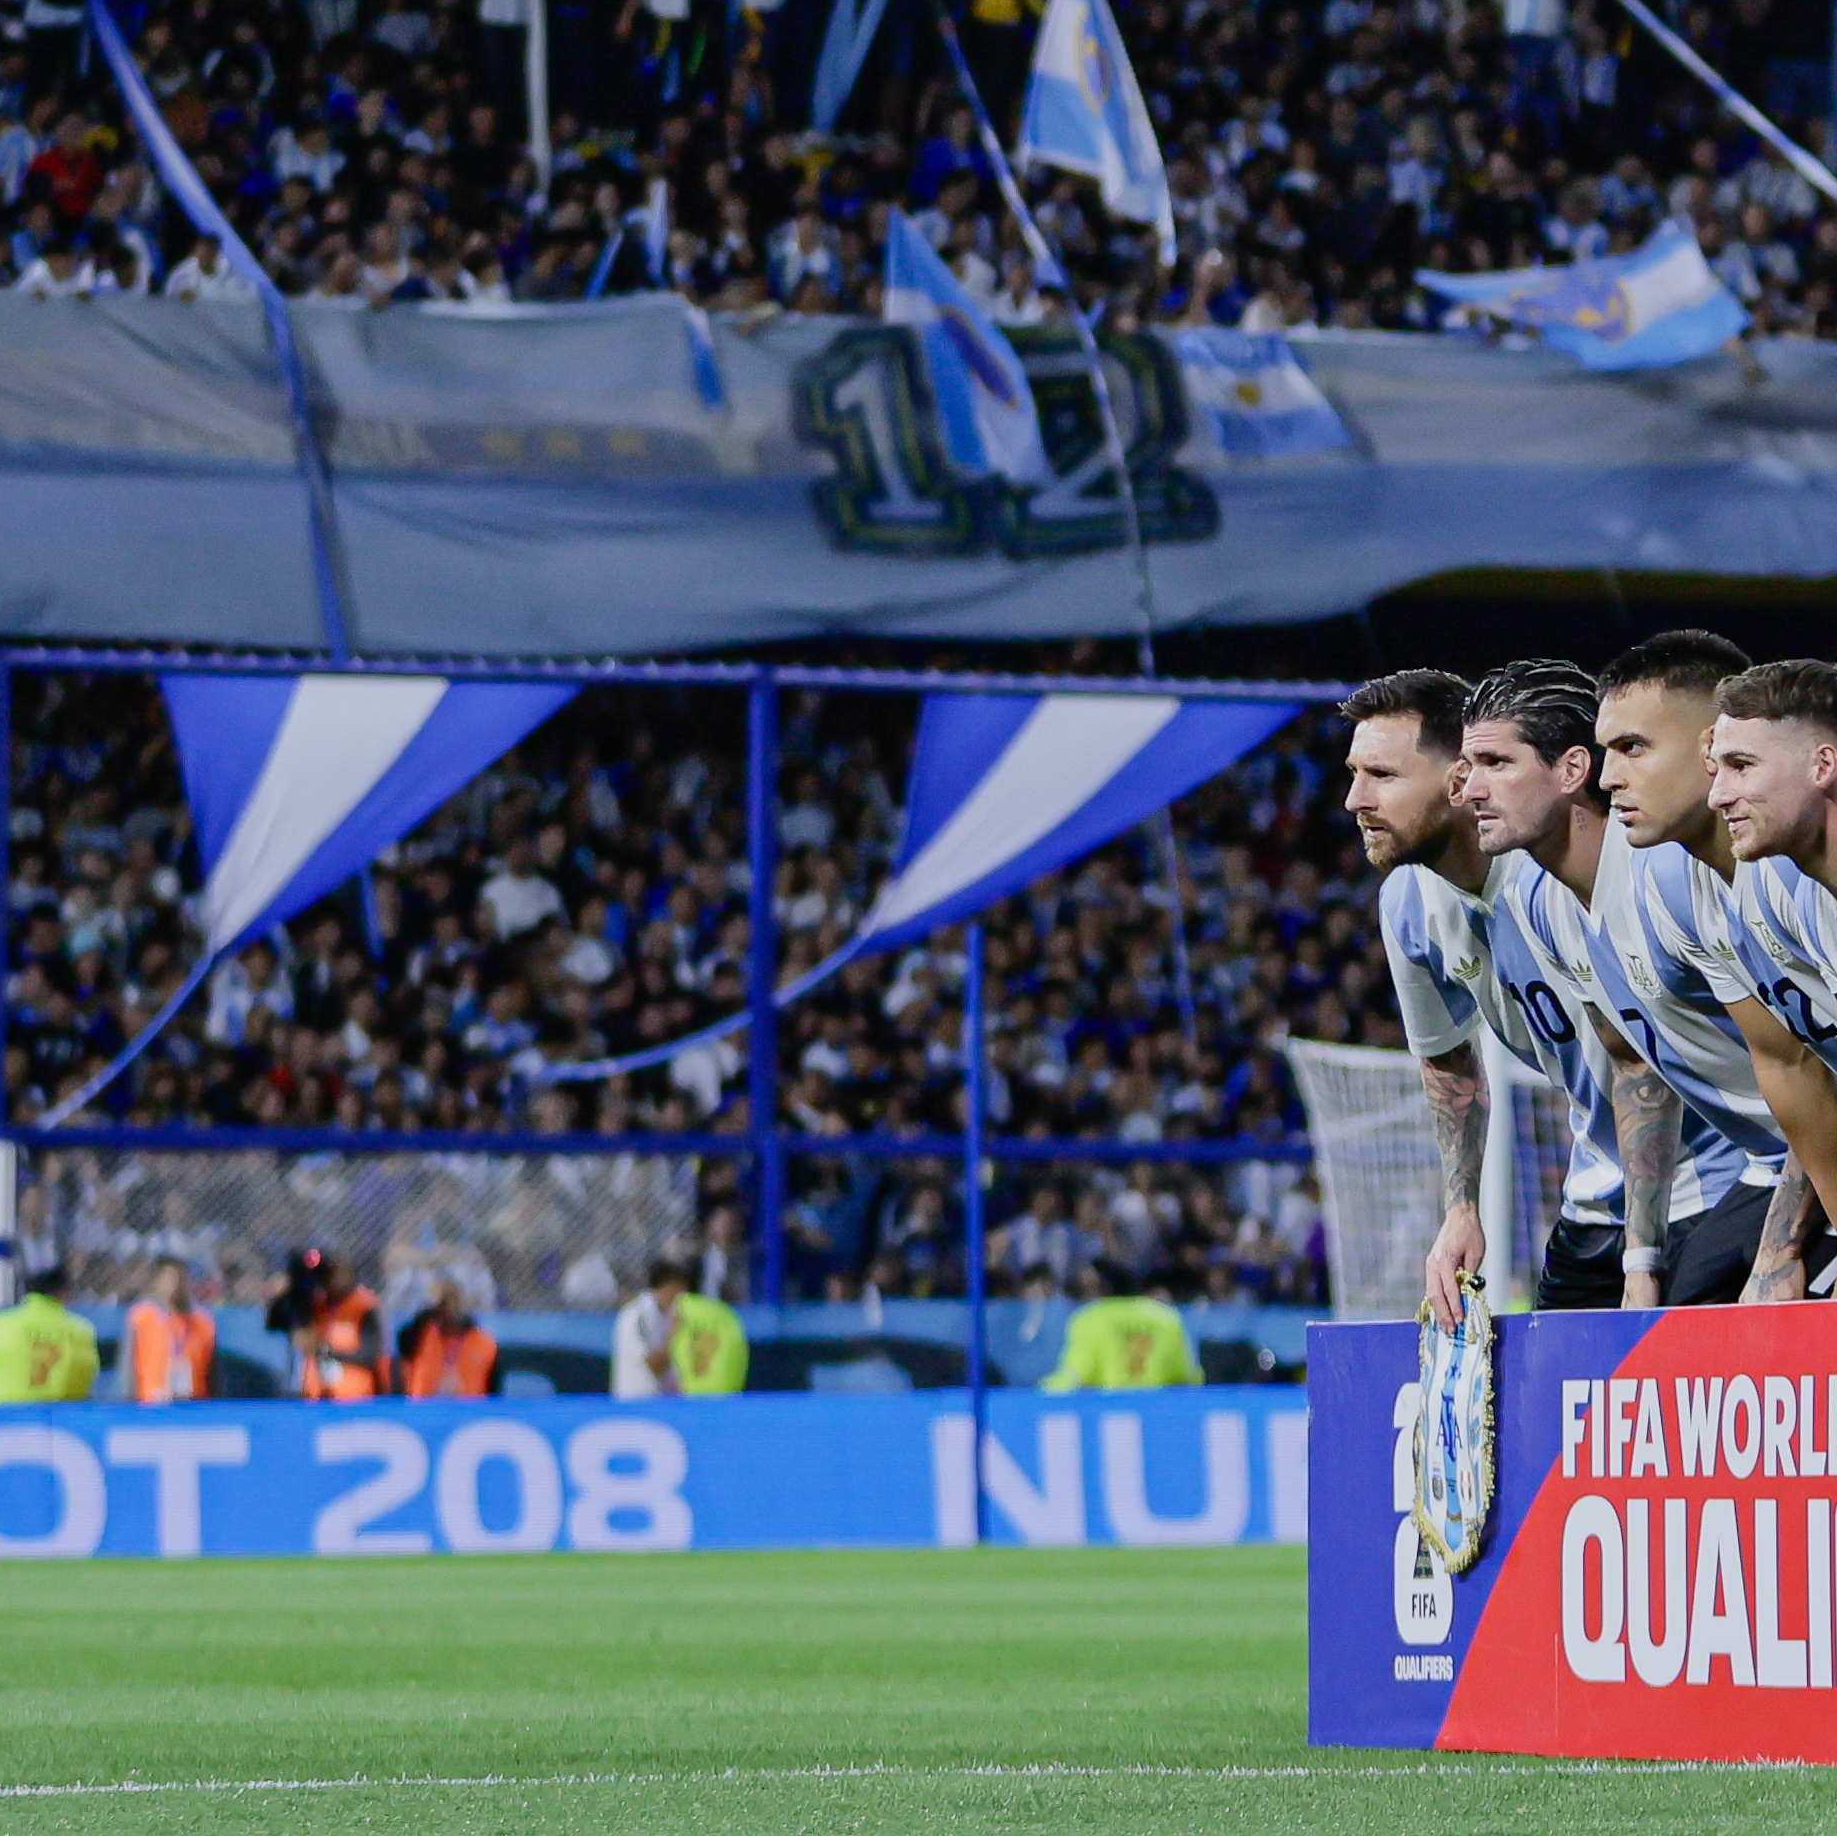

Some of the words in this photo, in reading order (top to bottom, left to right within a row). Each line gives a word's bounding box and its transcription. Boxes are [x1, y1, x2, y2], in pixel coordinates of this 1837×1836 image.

[1508, 979, 1577, 1044] 10
[1561, 1378, 1670, 1479] FIFA
[310, 1417, 696, 1558] 208
[1411, 1591, 1437, 1619] FIFA
[1393, 1654, 1455, 1683] QUALIFIERS
